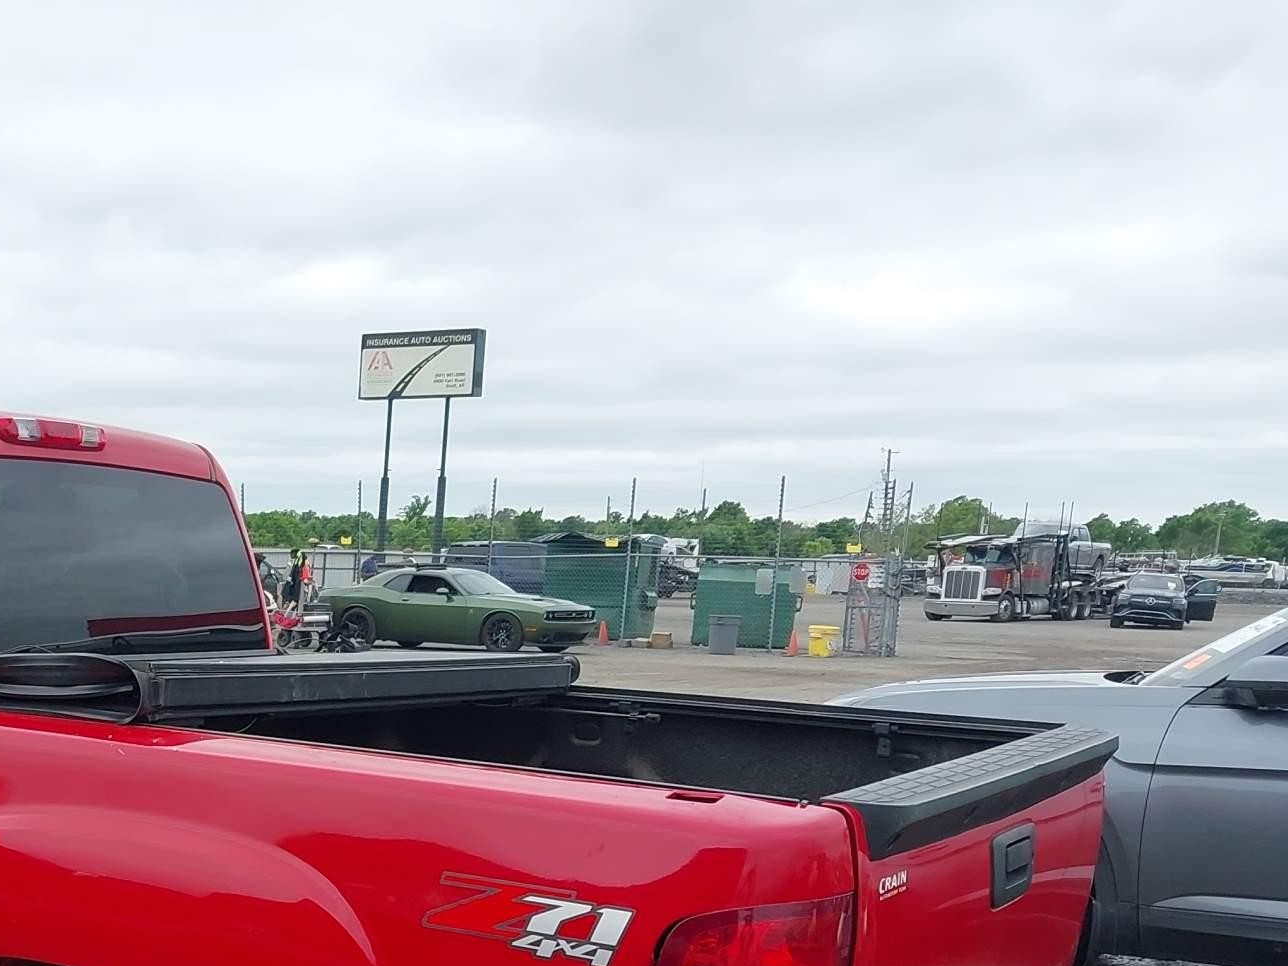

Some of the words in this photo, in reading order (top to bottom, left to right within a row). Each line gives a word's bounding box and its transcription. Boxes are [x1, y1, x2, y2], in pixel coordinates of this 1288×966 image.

[366, 336, 409, 347] INSURANCE
[410, 335, 432, 345] AUTO
[432, 334, 472, 343] AUCTIONS
[854, 568, 870, 576] STOP
[879, 869, 908, 895] CRAIN
[421, 871, 637, 948] Z71
